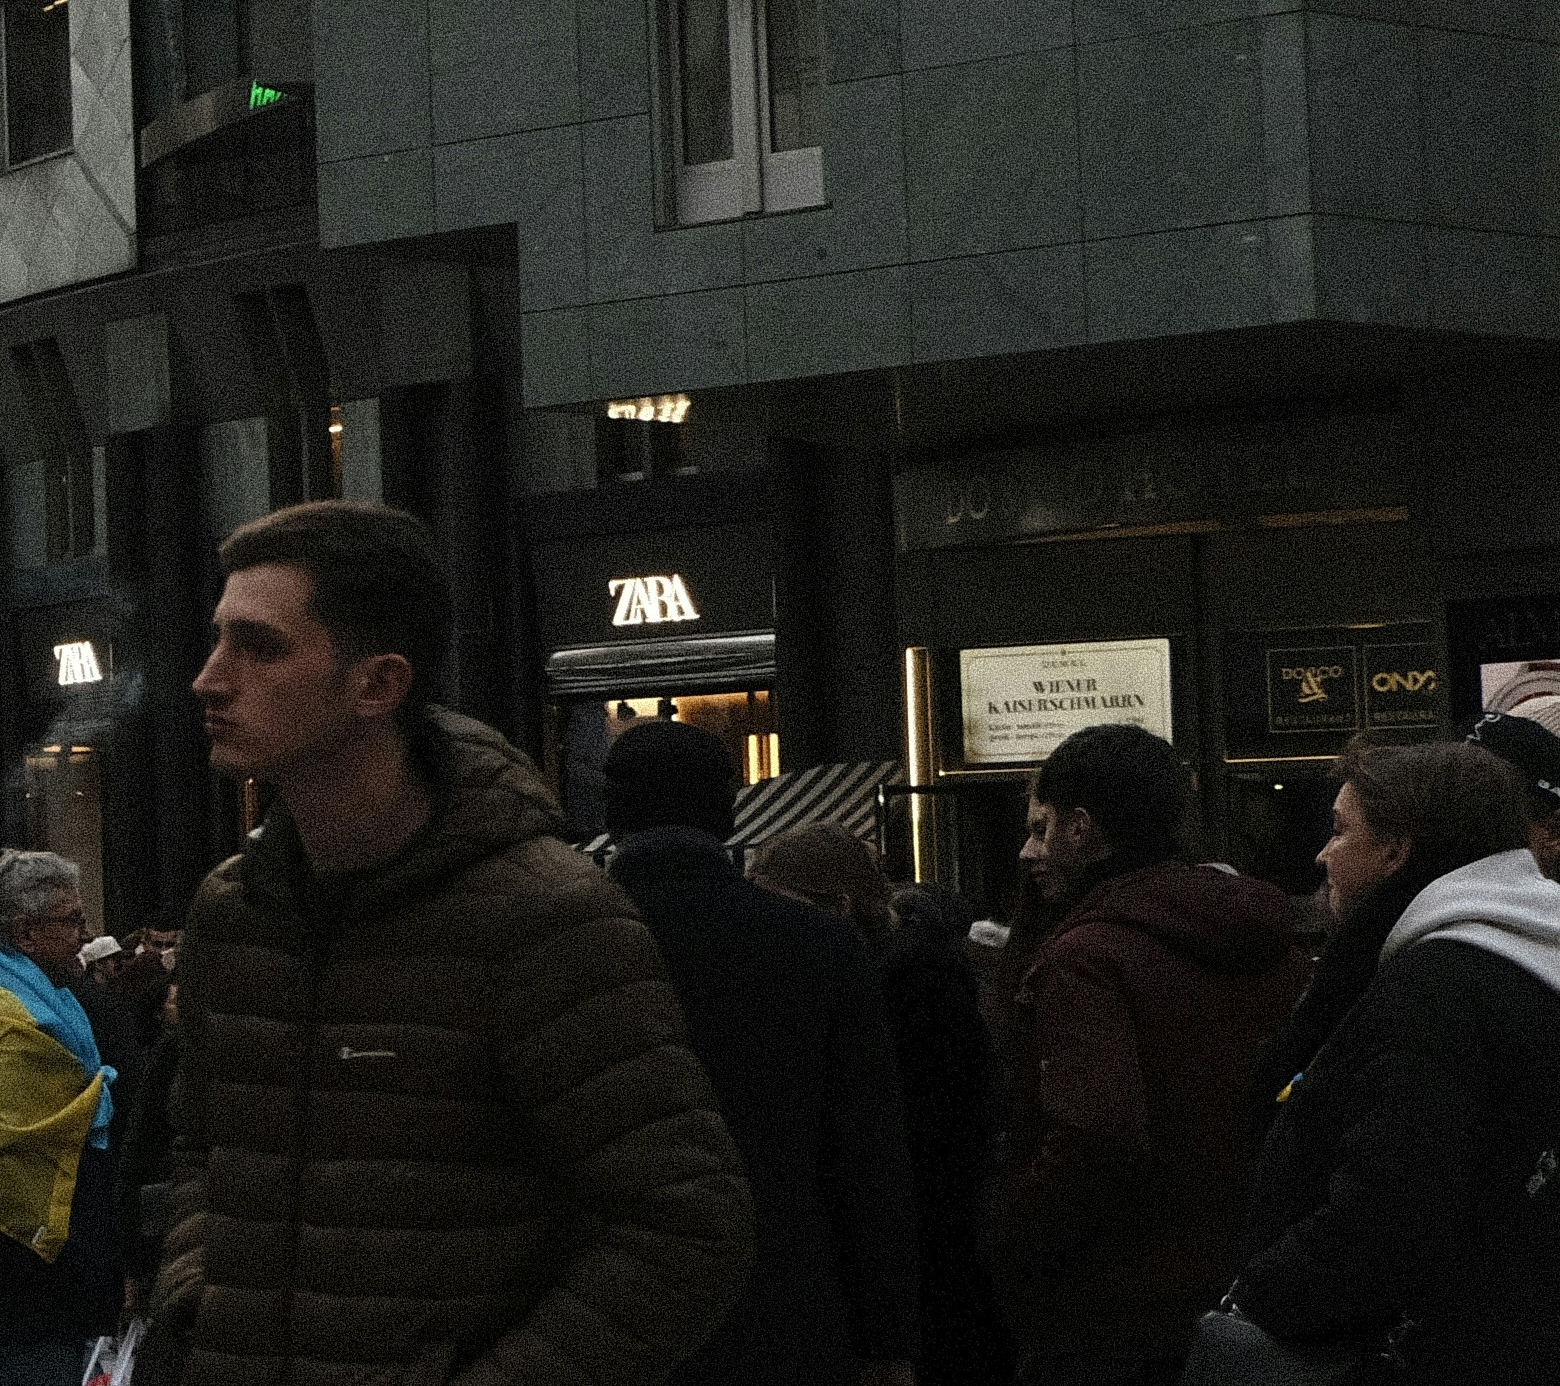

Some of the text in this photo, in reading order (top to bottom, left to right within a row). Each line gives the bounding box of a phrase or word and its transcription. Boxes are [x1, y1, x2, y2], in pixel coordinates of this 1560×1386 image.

[608, 573, 701, 626] ZARA
[1032, 678, 1098, 695] WIENER
[987, 693, 1145, 715] KAISERSCHMARRN
